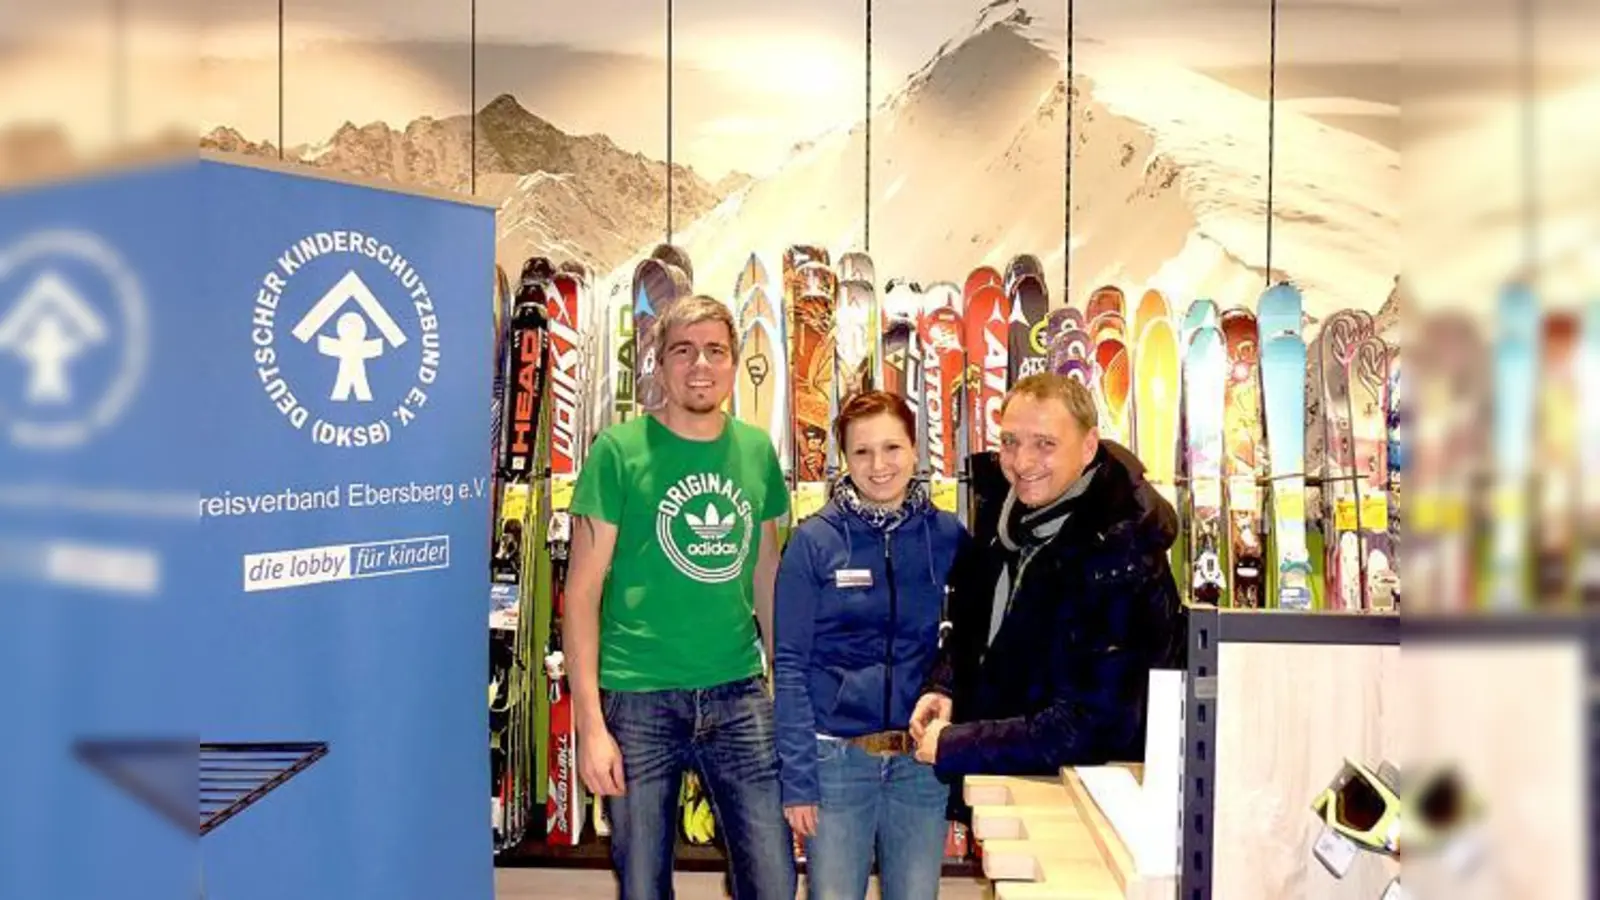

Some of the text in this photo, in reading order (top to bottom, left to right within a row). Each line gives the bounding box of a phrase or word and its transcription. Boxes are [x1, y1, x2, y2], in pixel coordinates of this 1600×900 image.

[252, 230, 440, 429] DEUTSCHER KINDERSCHUTZBUND E.V.
[512, 328, 540, 453] HEAD
[312, 419, 391, 447] (DKSB)
[199, 486, 340, 516] reisverband
[348, 482, 453, 506] Ebersberg
[458, 477, 487, 499] e.V.
[659, 472, 751, 517] ORIGINALS
[249, 541, 447, 582] die lobby für kinder
[687, 541, 737, 556] adidas
